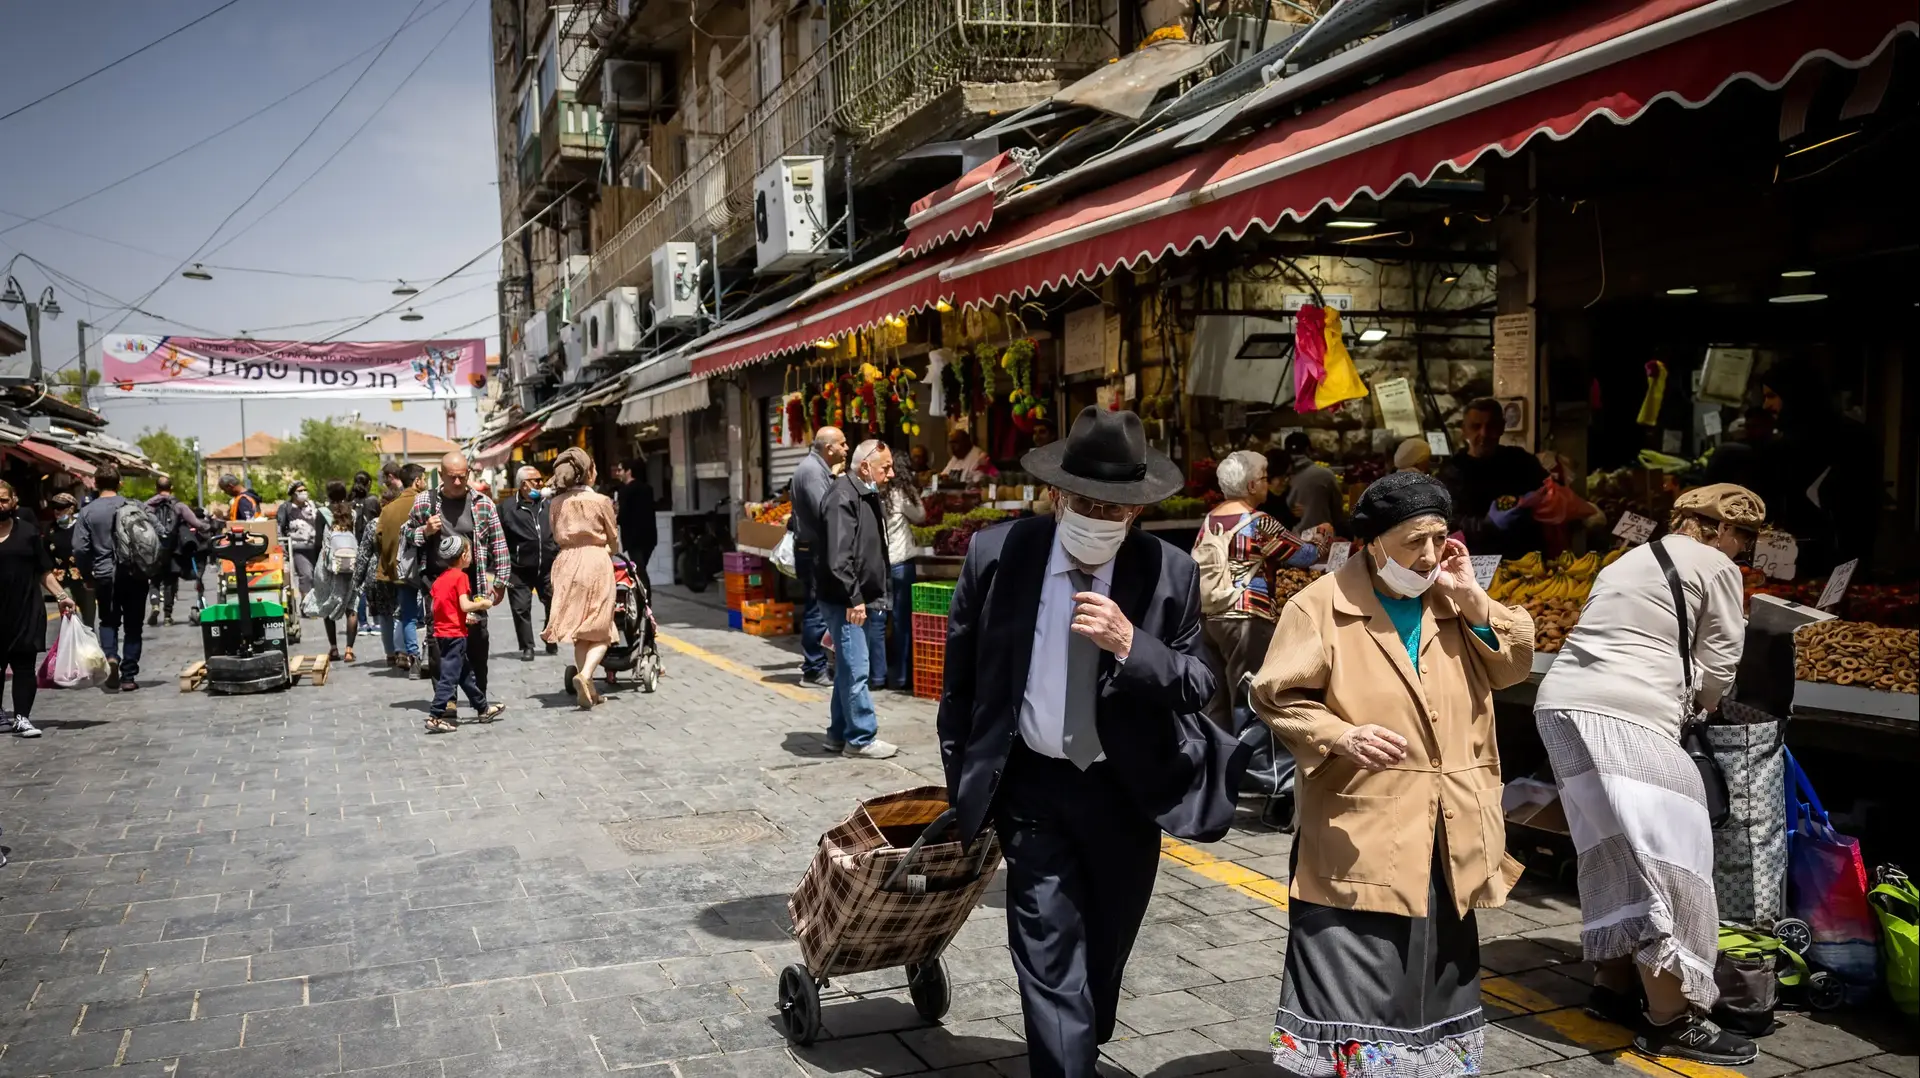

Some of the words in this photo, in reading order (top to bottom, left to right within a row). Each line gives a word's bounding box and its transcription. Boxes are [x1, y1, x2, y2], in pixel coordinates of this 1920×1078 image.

[208, 356, 289, 380] שמח!
[300, 367, 358, 386] פסח
[365, 372, 397, 388] חג
